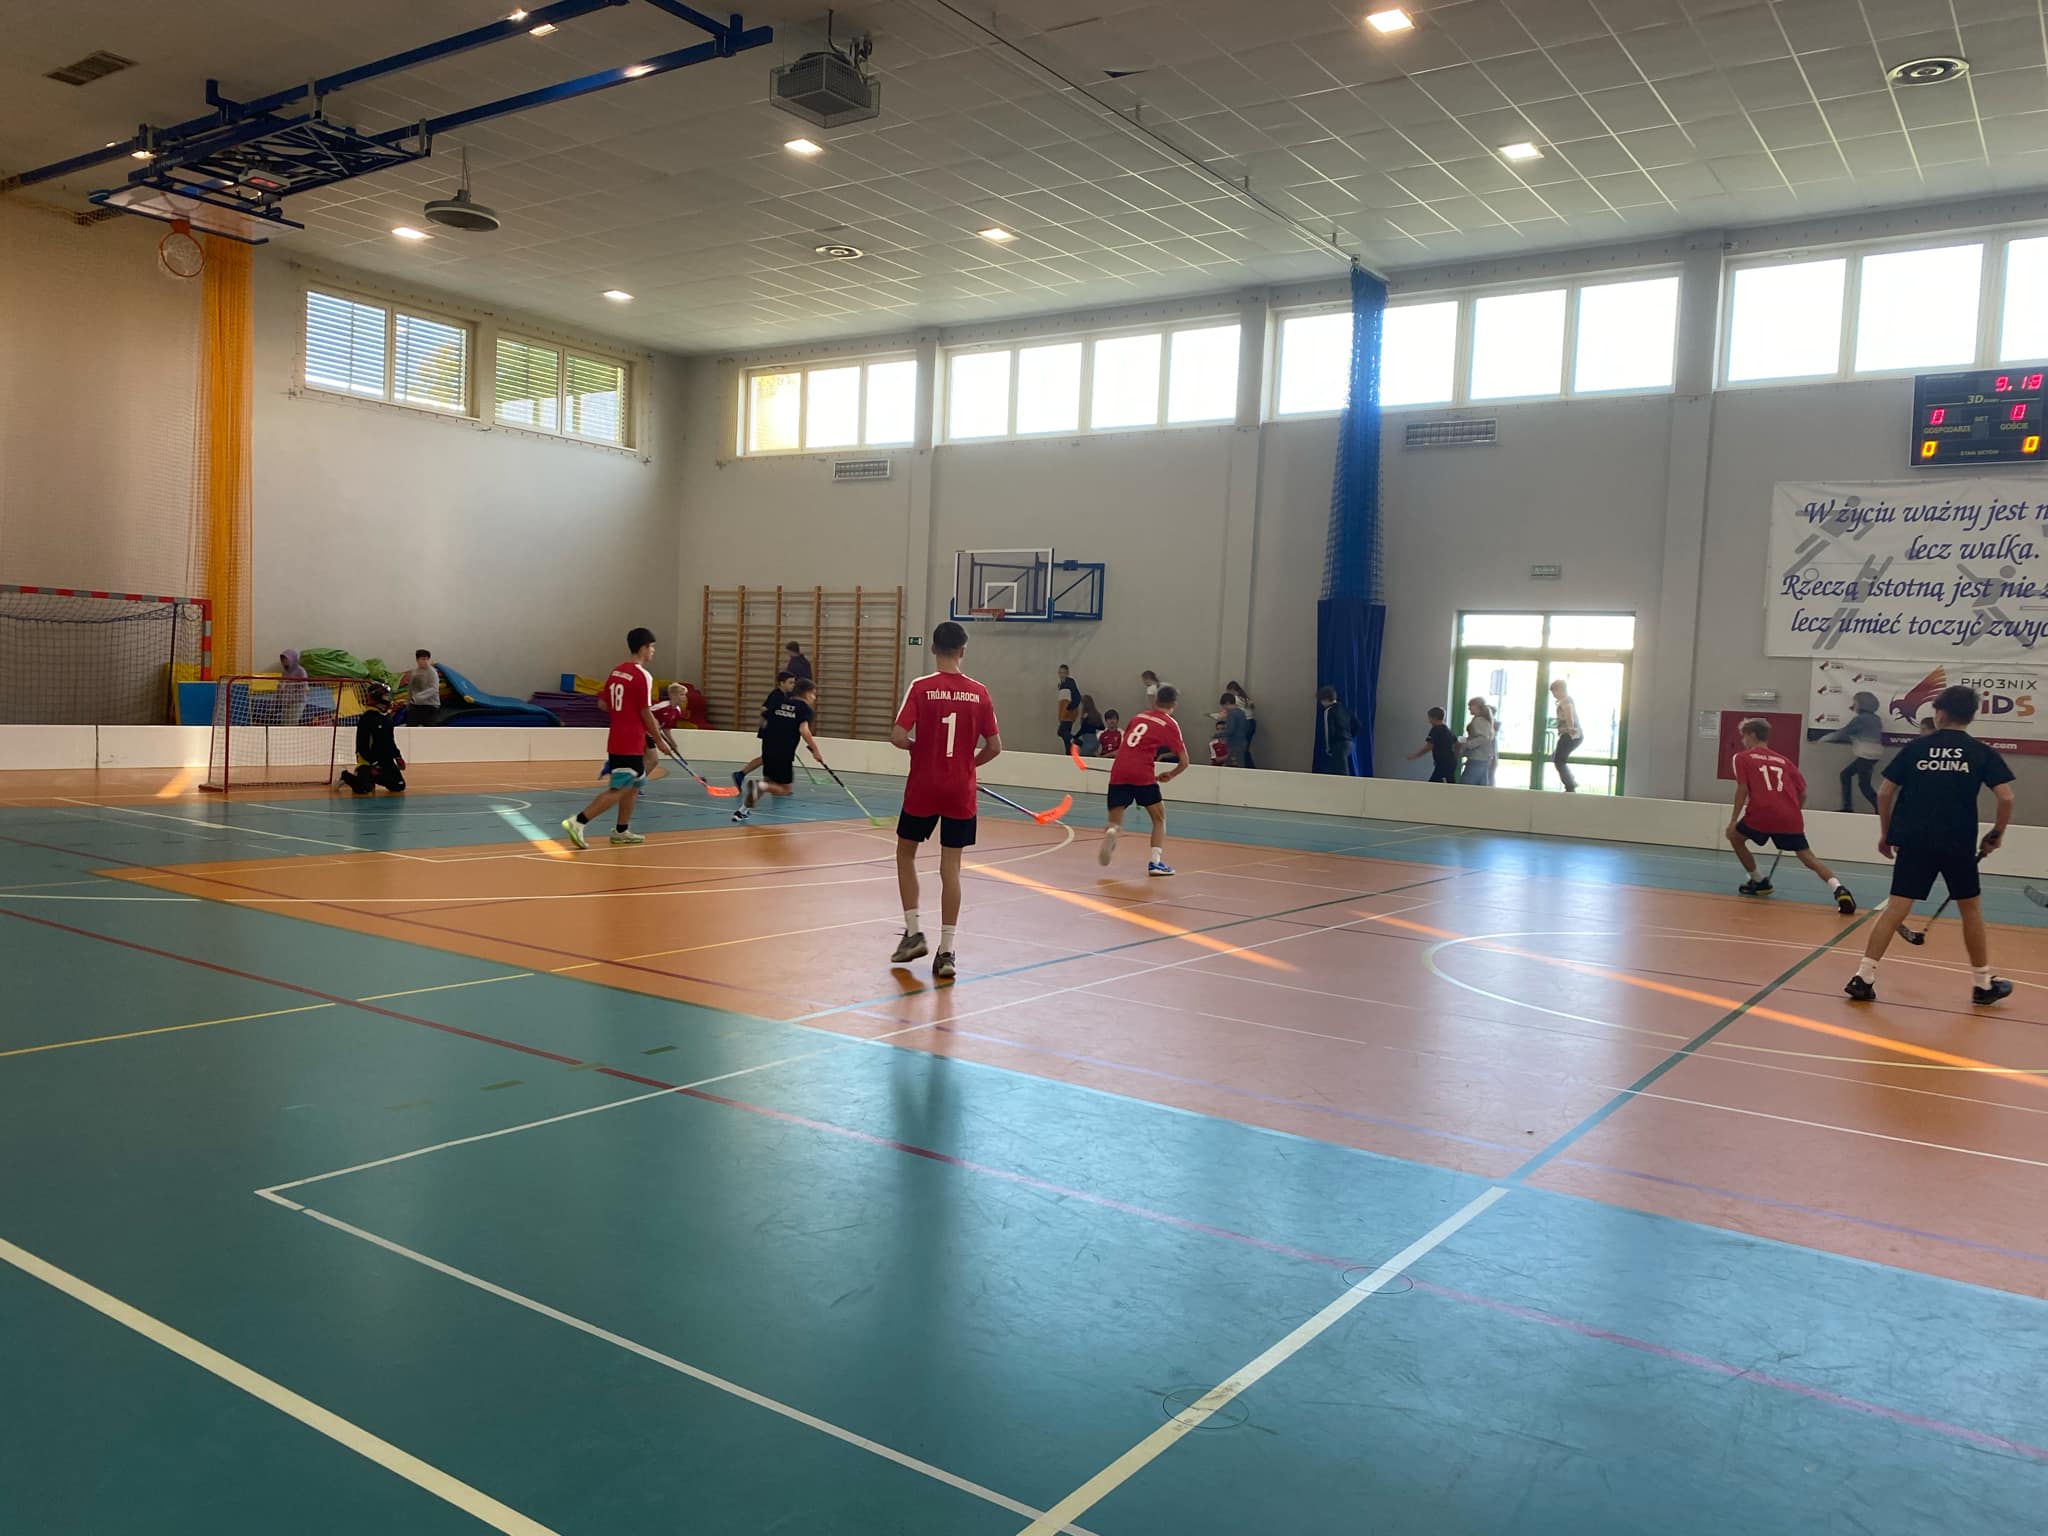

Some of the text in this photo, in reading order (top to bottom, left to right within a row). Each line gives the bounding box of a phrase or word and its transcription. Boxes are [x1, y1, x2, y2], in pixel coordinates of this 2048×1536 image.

[1930, 408, 1945, 425] 0
[2010, 404, 2026, 421] 0
[1921, 440, 1937, 458] 0
[2022, 435, 2039, 453] 0
[1805, 499, 2048, 532] W życiu ważny jest n
[1908, 533, 2039, 565] lecz walka.
[1780, 575, 1859, 601] Rzeczą
[1867, 575, 1945, 602] istotną
[1944, 576, 1993, 607] jest
[2000, 575, 2036, 598] nie
[1791, 607, 2048, 647] lecz umieć toczyć zwyc
[609, 682, 625, 712] 18
[926, 688, 980, 704] TRÓJKA JAROCIN
[942, 712, 957, 758] 1
[1127, 722, 1149, 748] 8
[1929, 747, 1963, 759] UKS
[1759, 765, 1784, 792] 17
[1916, 759, 1970, 774] GOLINA
